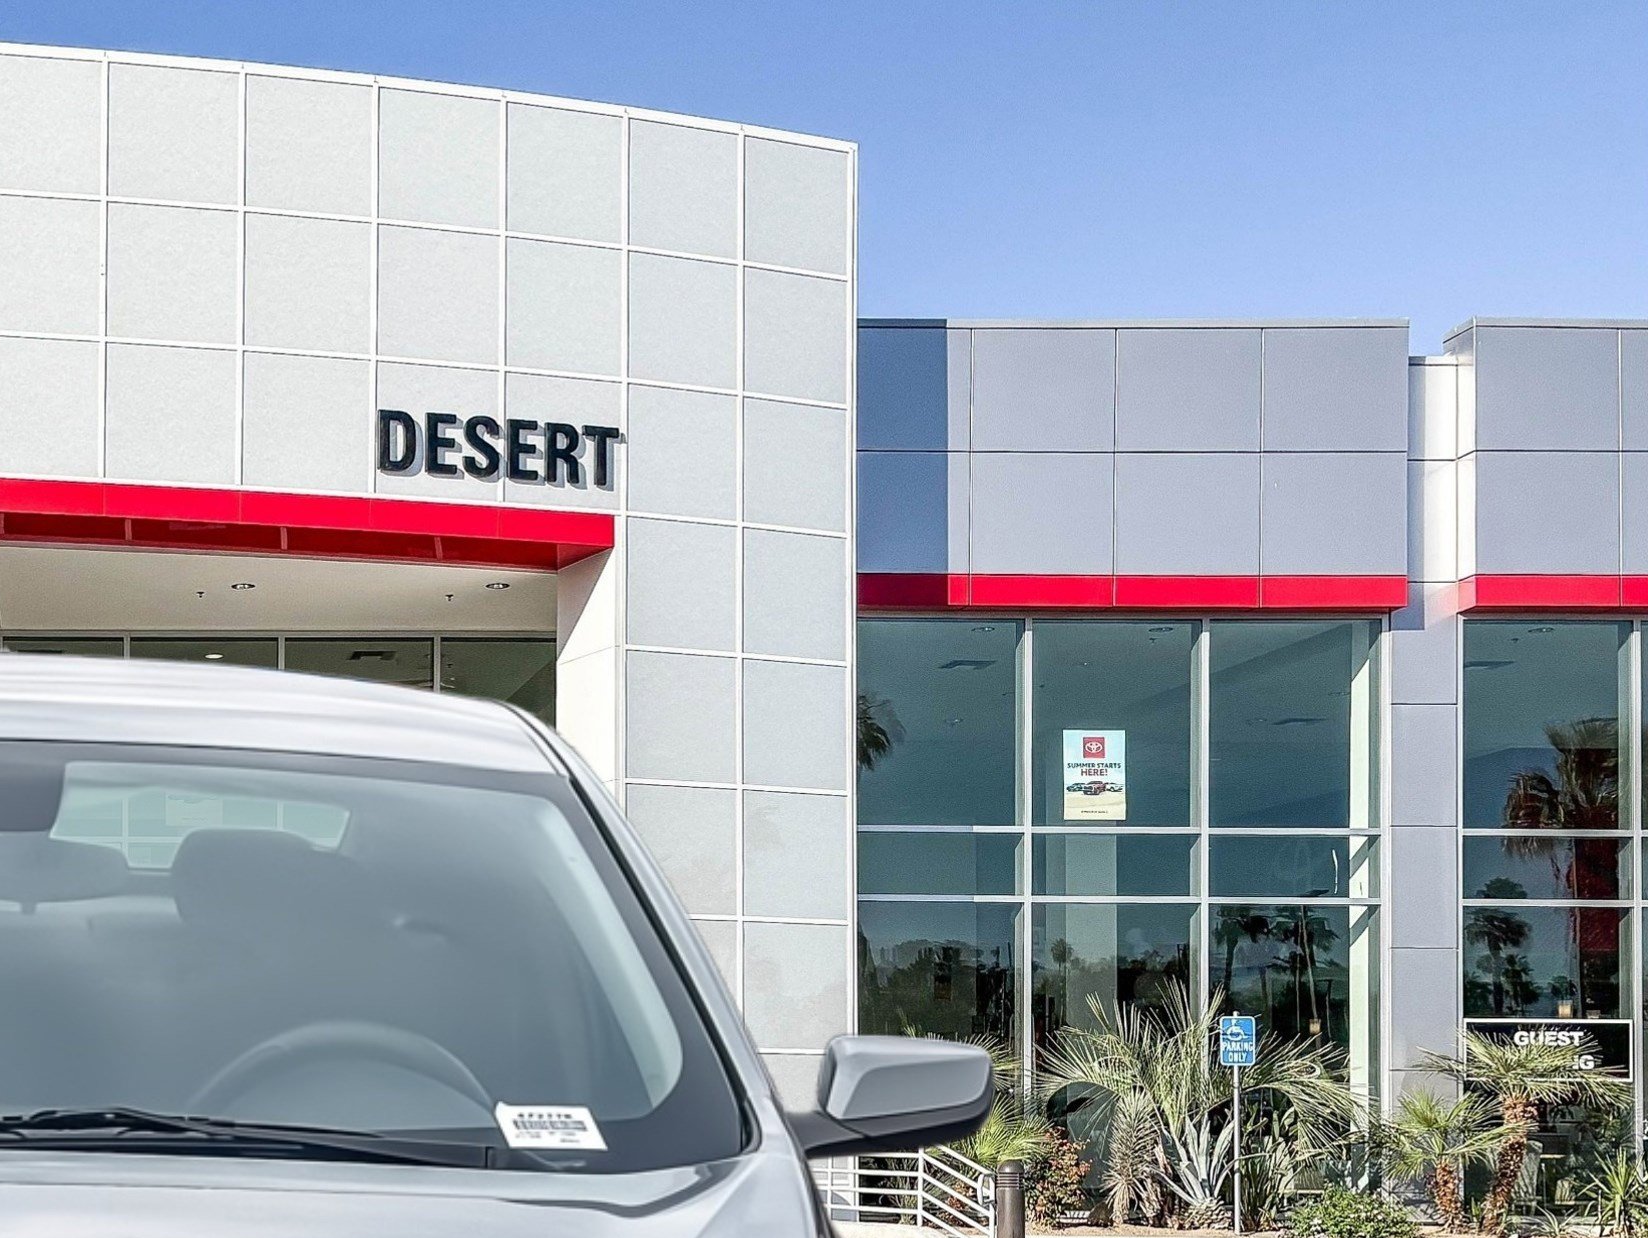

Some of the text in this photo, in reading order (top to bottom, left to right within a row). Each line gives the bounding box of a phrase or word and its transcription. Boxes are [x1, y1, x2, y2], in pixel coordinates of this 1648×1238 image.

[377, 409, 620, 487] DESERT
[1514, 1031, 1584, 1047] GUEST
[1222, 1042, 1254, 1052] PARKING
[1228, 1052, 1247, 1062] ONLY
